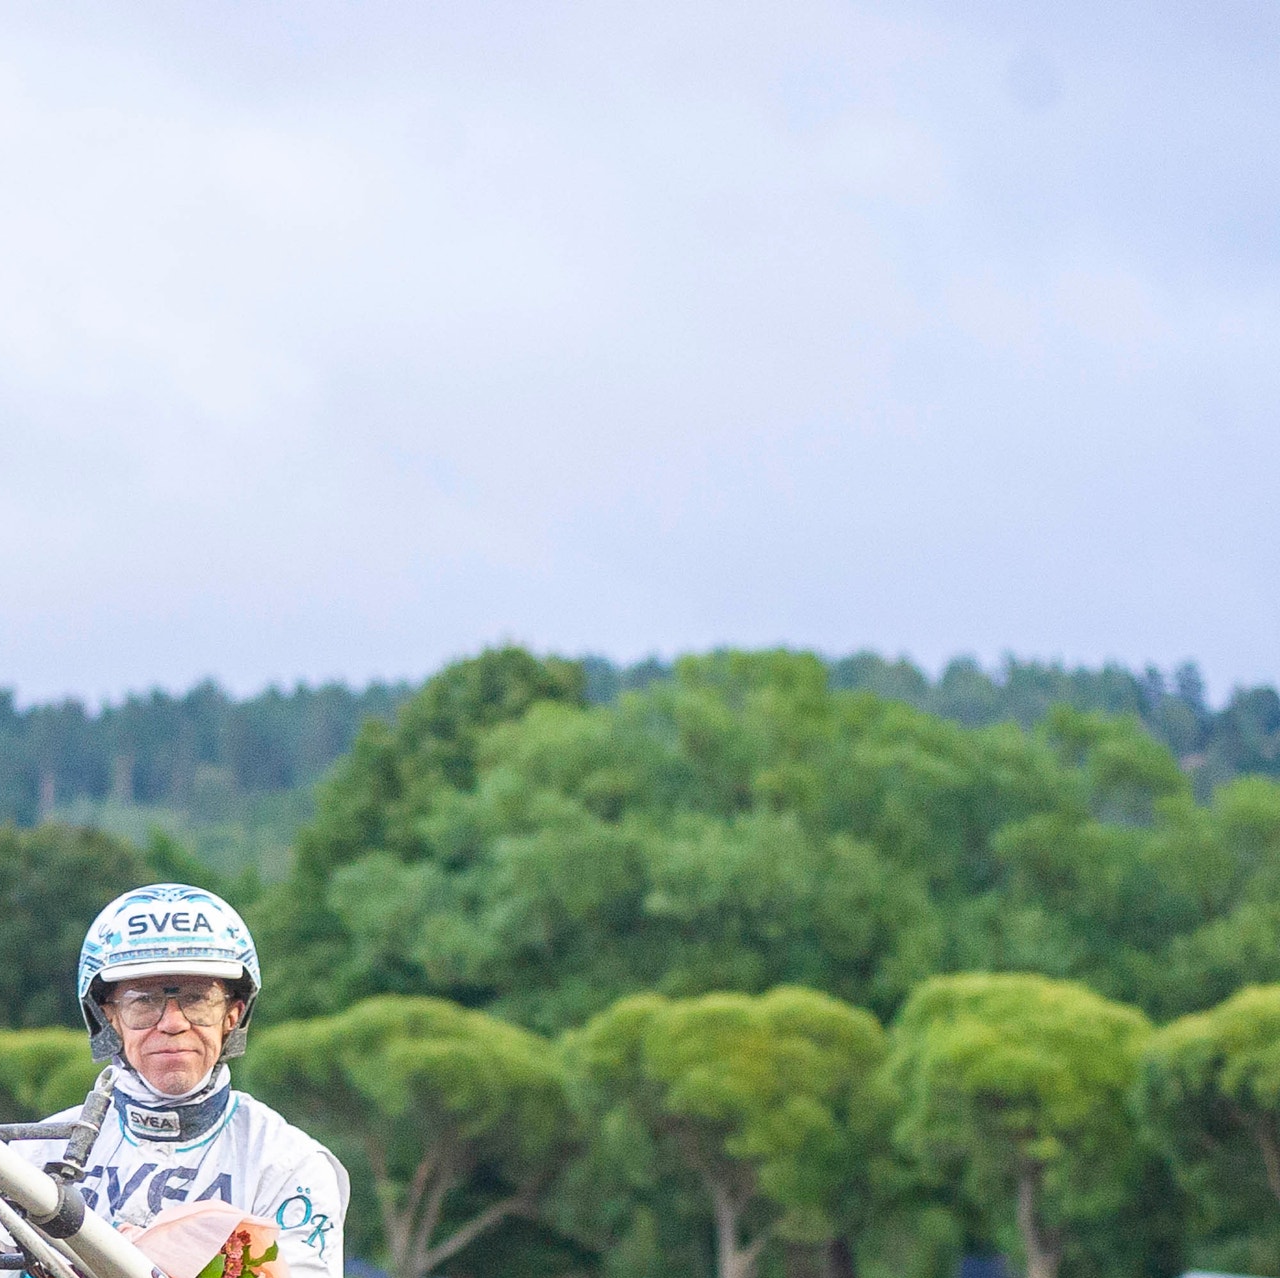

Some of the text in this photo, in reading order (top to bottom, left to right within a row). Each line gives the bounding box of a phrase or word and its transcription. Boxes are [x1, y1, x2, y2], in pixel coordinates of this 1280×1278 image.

[128, 912, 213, 935] SVEA
[131, 1111, 173, 1128] SVEA
[276, 1186, 334, 1264] ÖK
